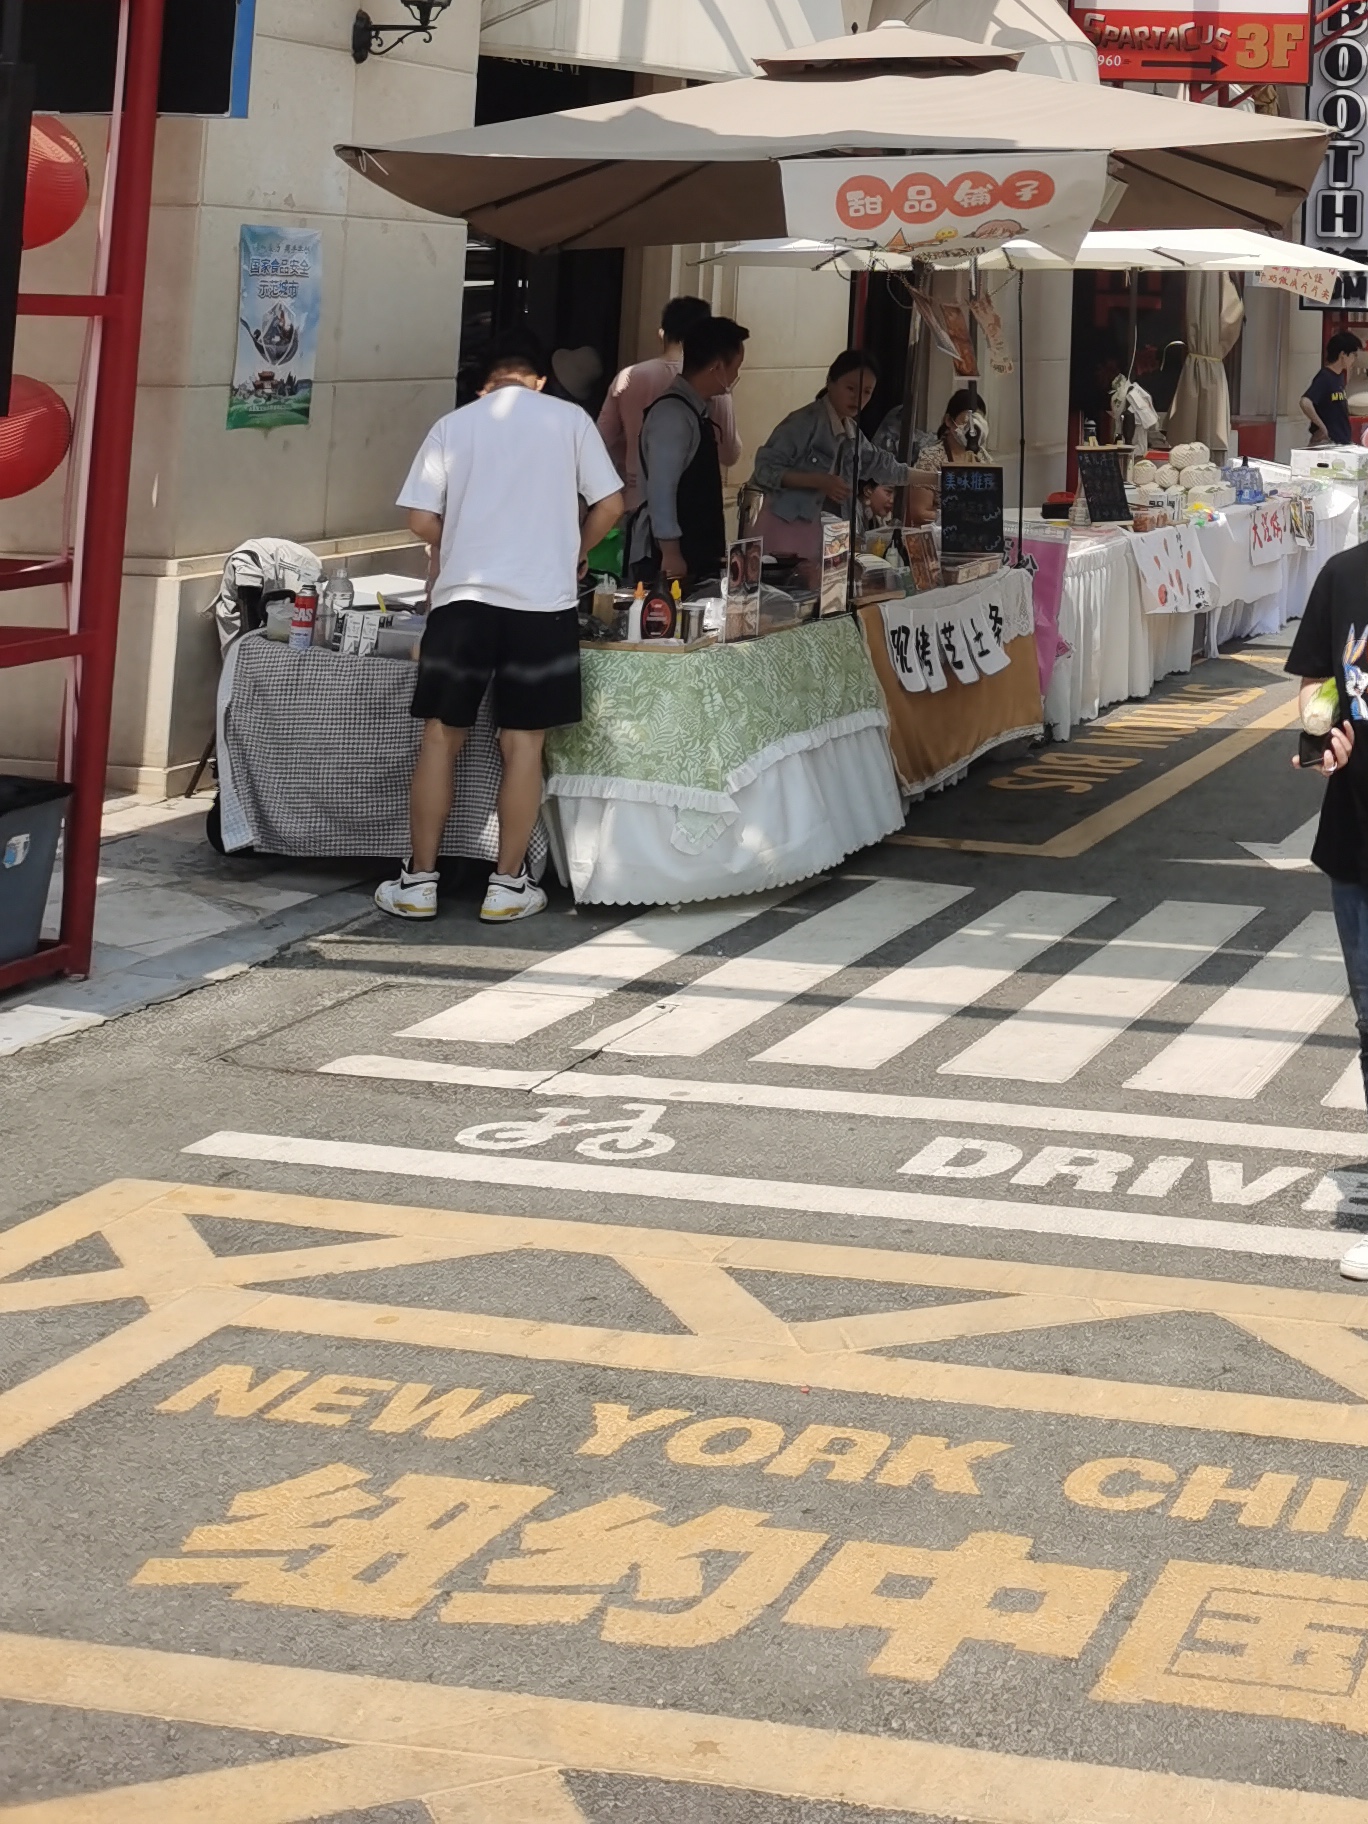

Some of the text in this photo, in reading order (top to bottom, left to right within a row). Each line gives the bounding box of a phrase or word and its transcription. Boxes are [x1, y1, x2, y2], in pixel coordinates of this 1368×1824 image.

[1082, 12, 1304, 69] SPARTACUS 3F
[1097, 54, 1122, 67] 960
[249, 257, 312, 277] 国家食品安全
[257, 279, 299, 298] 示范城市
[155, 1362, 532, 1439] NEW
[574, 1401, 1013, 1495] YORK
